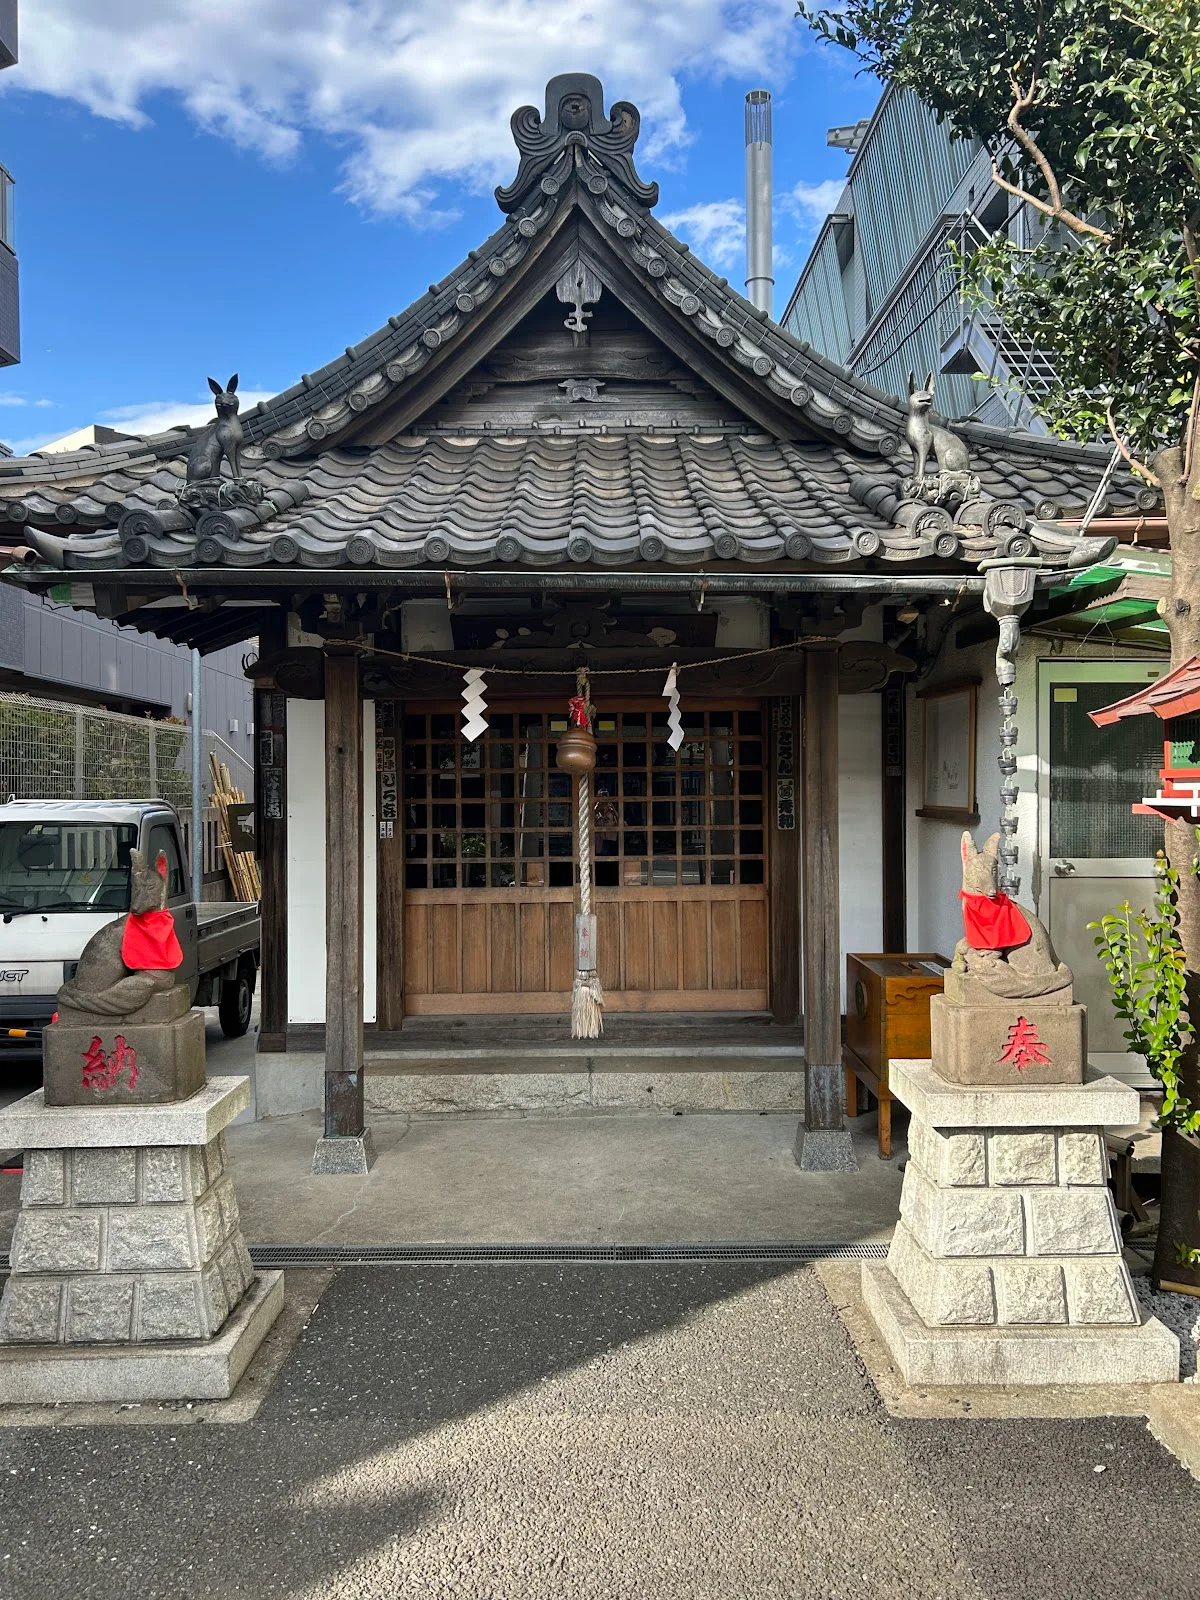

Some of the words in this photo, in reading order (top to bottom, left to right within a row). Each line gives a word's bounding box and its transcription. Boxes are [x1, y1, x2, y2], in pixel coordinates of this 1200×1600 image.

[580, 927, 589, 958] 奉納
[81, 1034, 139, 1090] 納
[995, 1015, 1053, 1073] 奉
